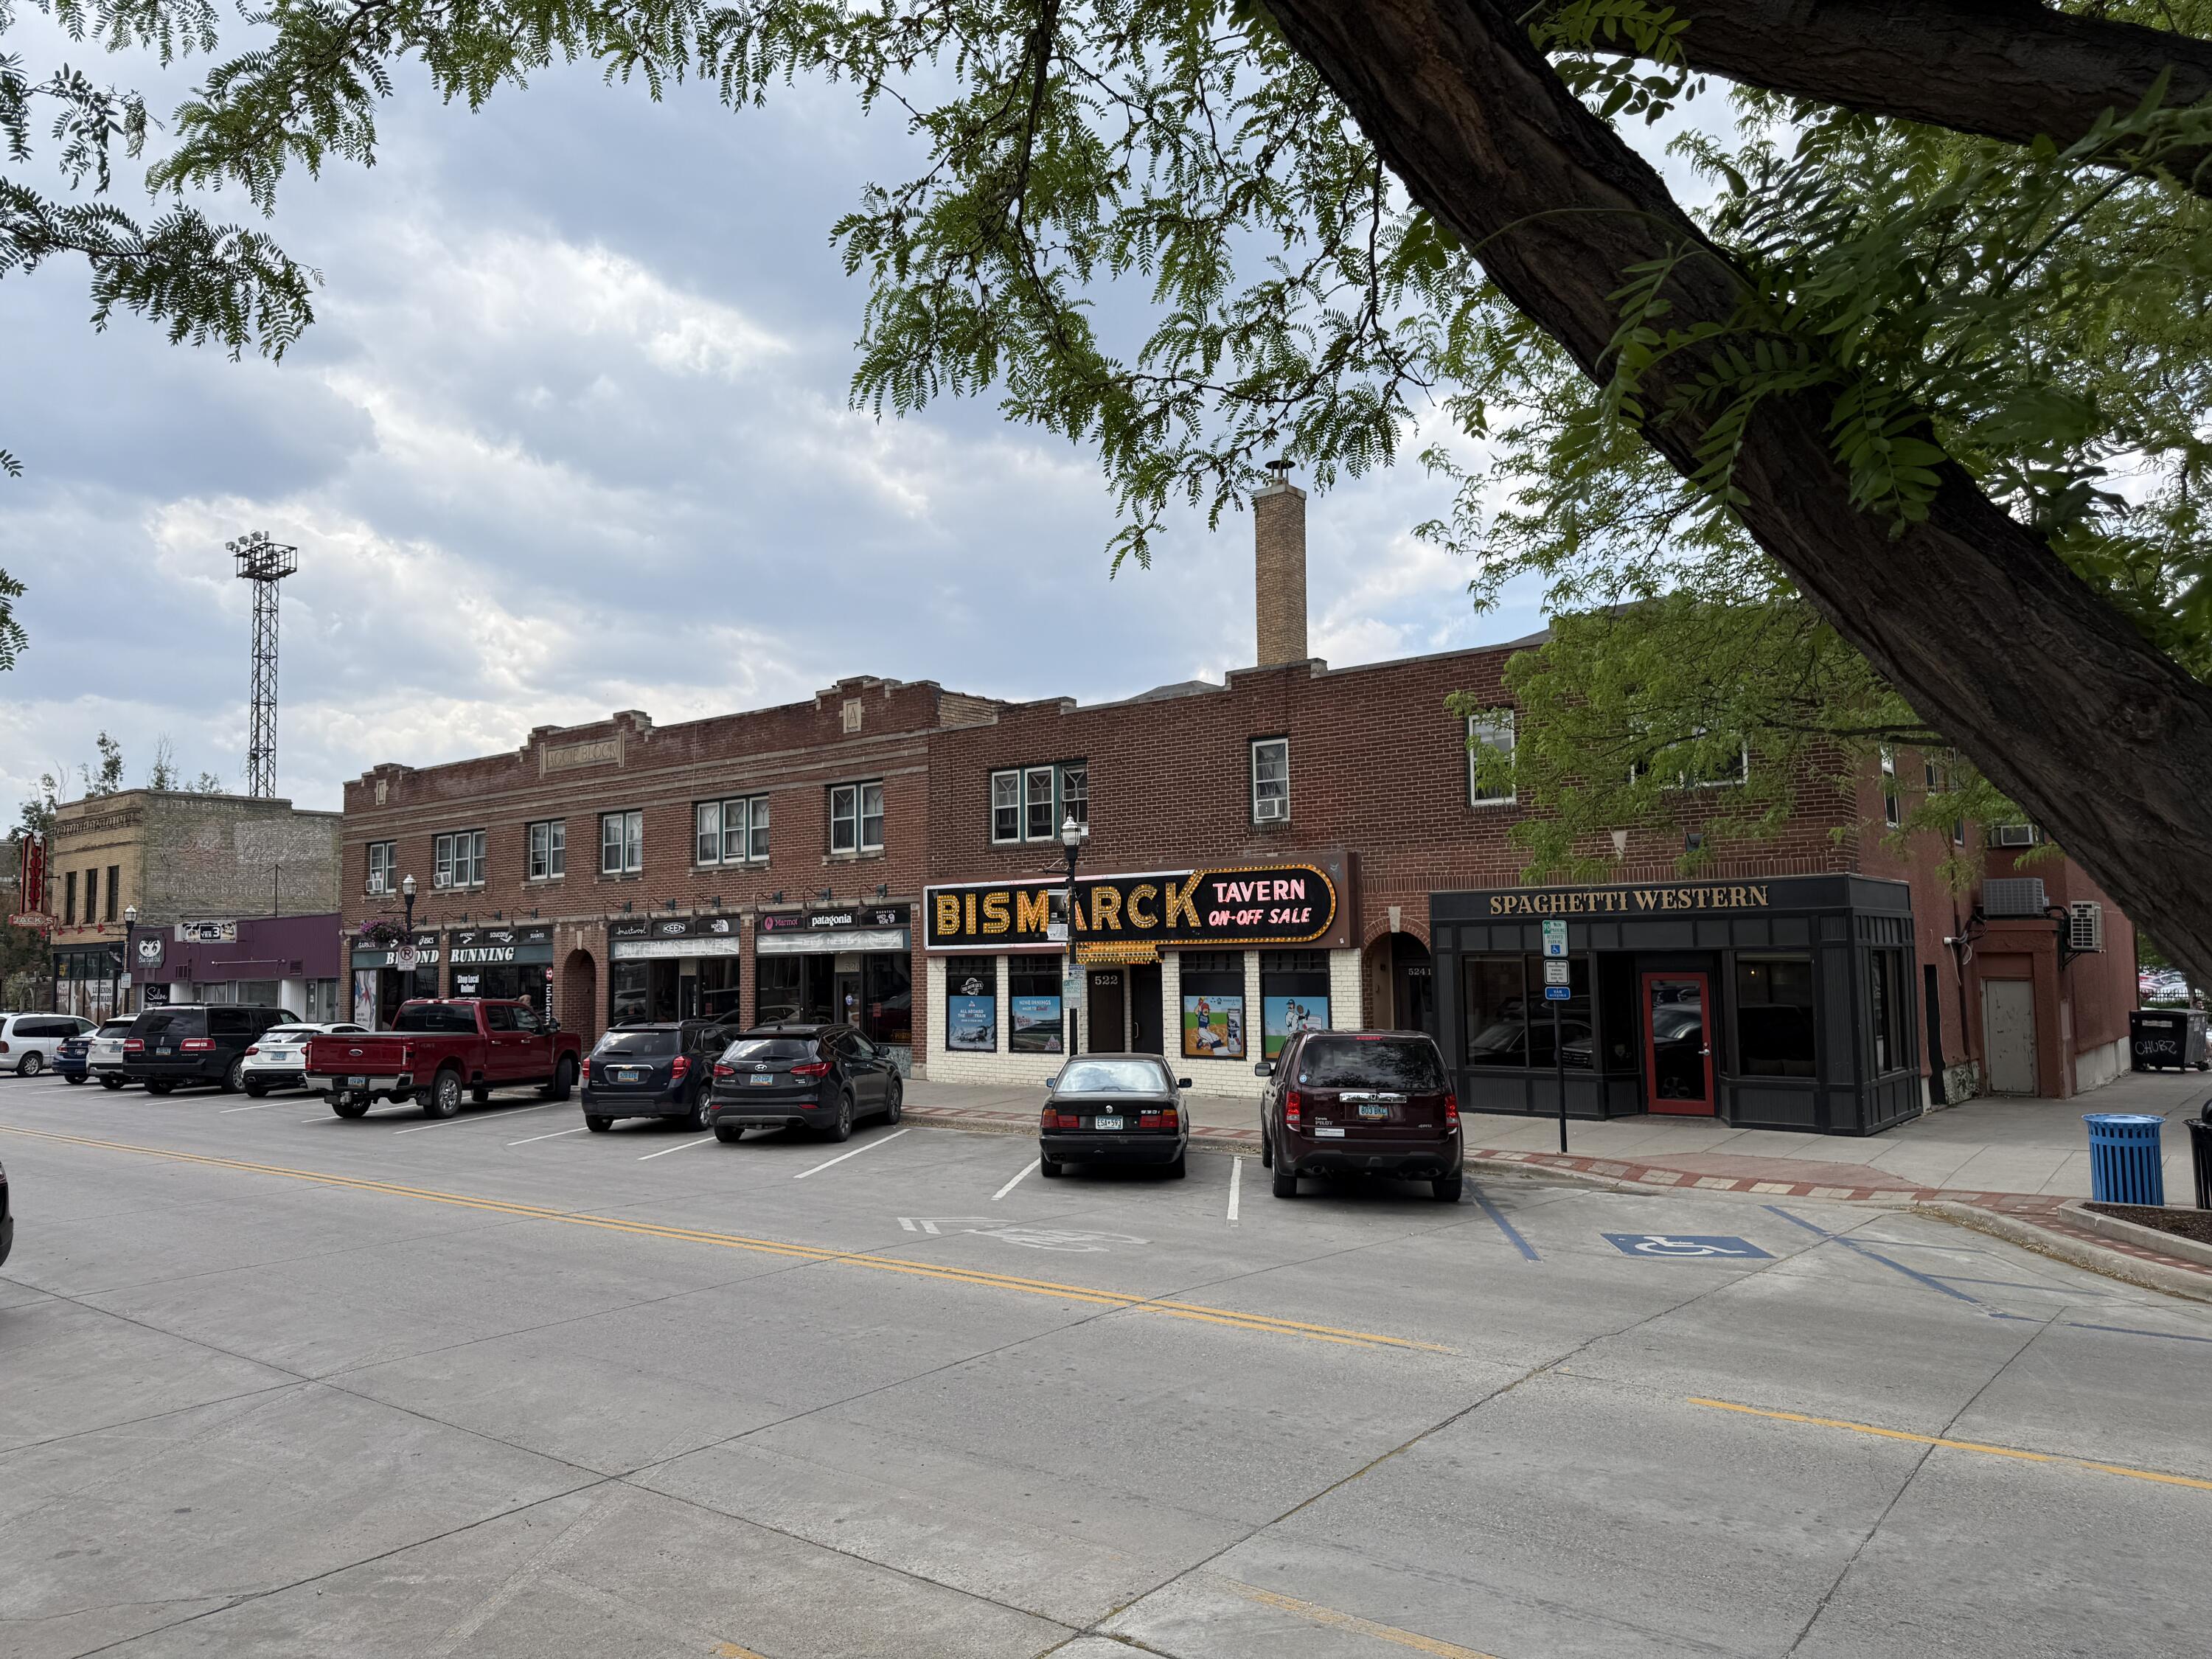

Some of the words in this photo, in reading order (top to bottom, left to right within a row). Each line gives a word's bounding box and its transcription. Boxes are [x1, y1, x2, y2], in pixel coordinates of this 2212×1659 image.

[582, 743, 616, 761] BLOCK
[29, 846, 43, 910] COWBOY
[1213, 879, 1304, 903] TAVERN
[1489, 891, 1629, 915] SPAGHETTI
[1632, 886, 1769, 910] WESTERN
[13, 917, 54, 925] JACK'S
[812, 914, 852, 927] patagonia
[1208, 908, 1262, 926] ON-OFF
[1270, 908, 1312, 925] SALE
[213, 927, 220, 936] 3
[664, 923, 685, 932] KEEN
[622, 941, 685, 956] OUTERMOST
[692, 939, 731, 954] LAYER
[386, 950, 439, 965] BOND
[450, 947, 515, 962] RUNNING
[468, 975, 479, 984] Local
[1095, 975, 1118, 985] 522
[147, 987, 167, 1001] Salon
[2135, 1040, 2177, 1055] CHUBZ
